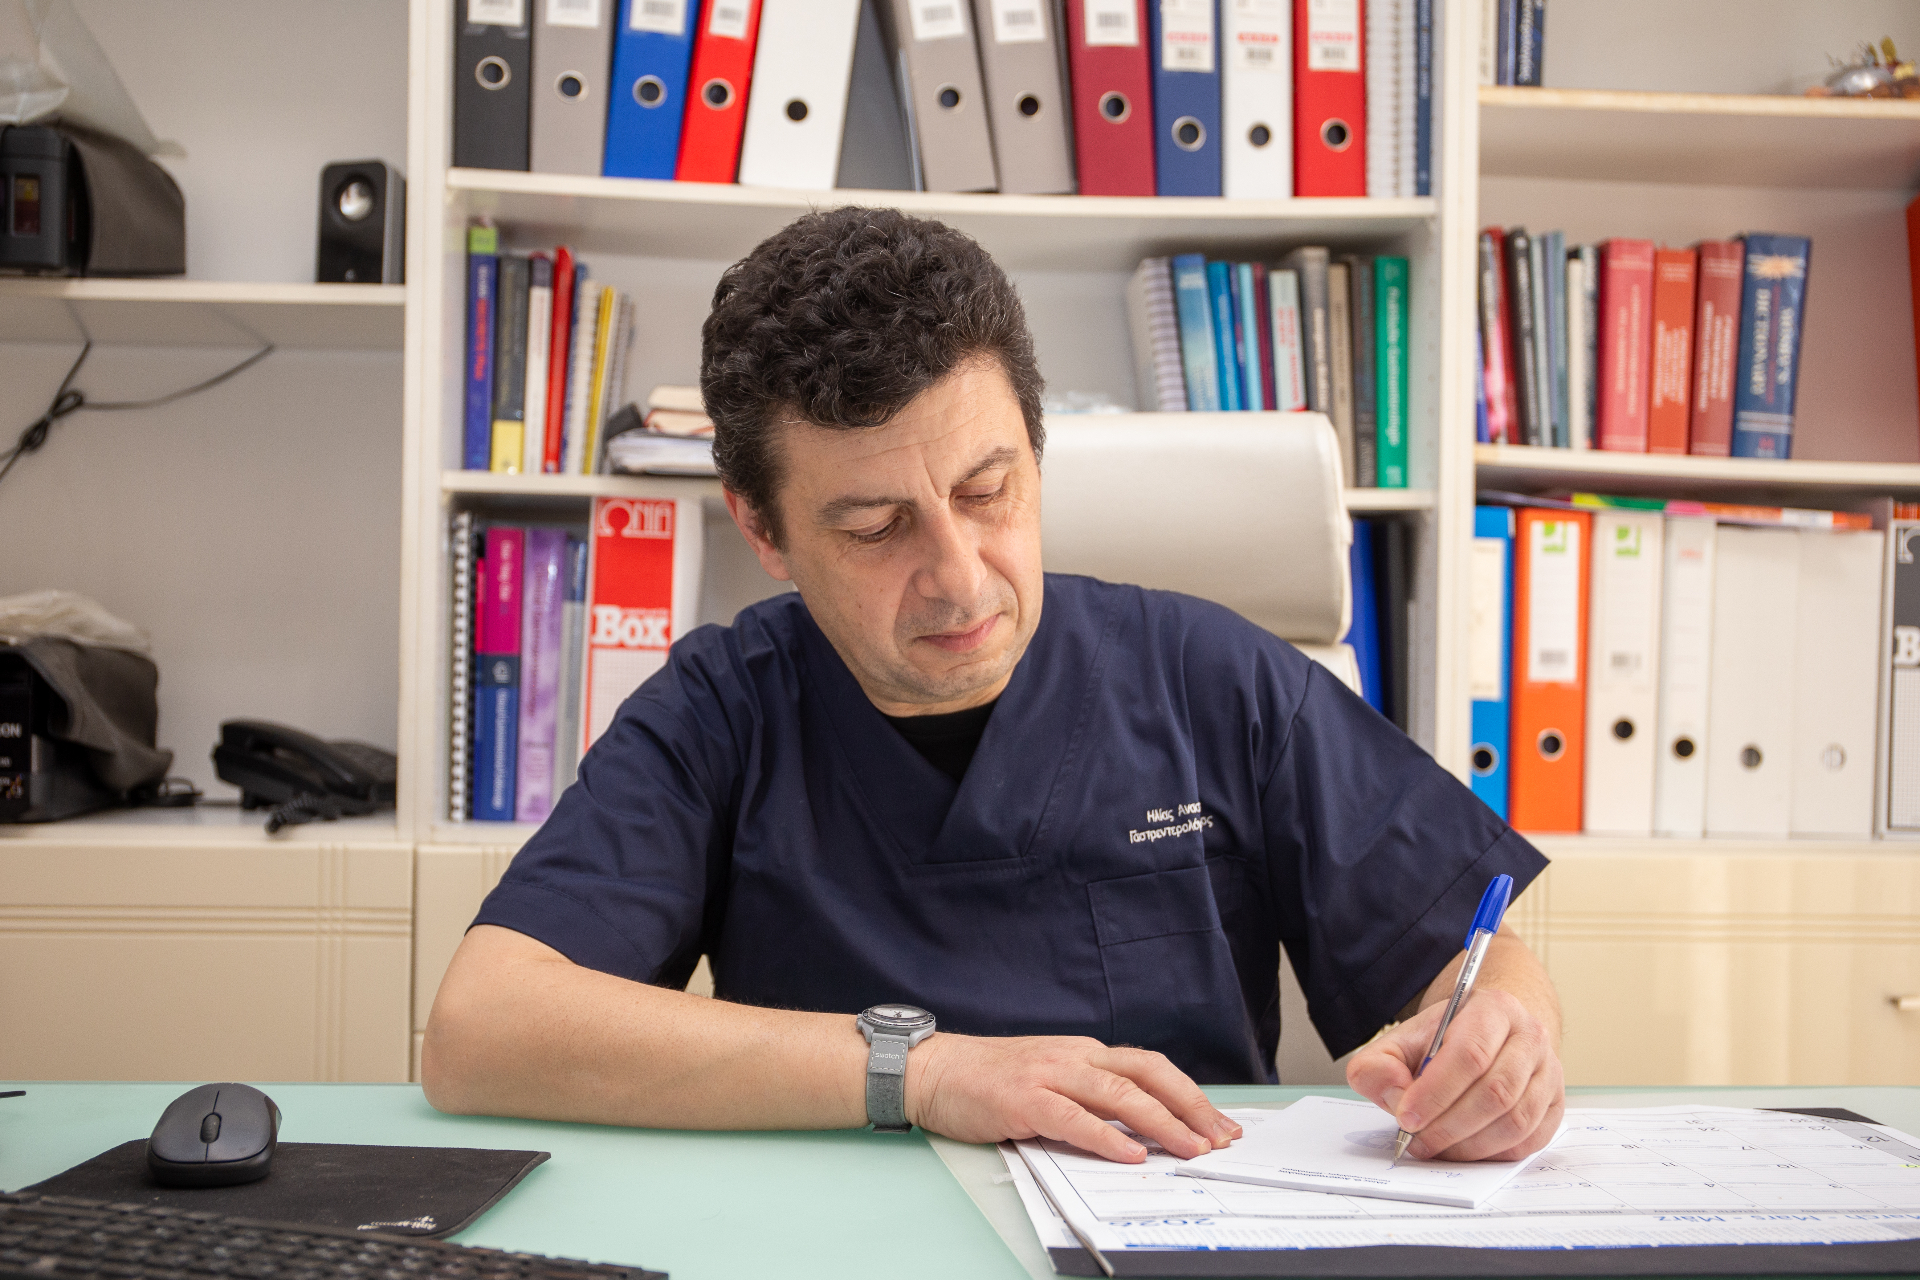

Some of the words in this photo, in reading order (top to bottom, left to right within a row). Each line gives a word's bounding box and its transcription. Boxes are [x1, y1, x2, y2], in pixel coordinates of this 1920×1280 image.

[592, 605, 668, 646] Box
[874, 1052, 900, 1060] swatch
[1860, 1135, 1890, 1143] 12
[1109, 1218, 1215, 1227] 2026
